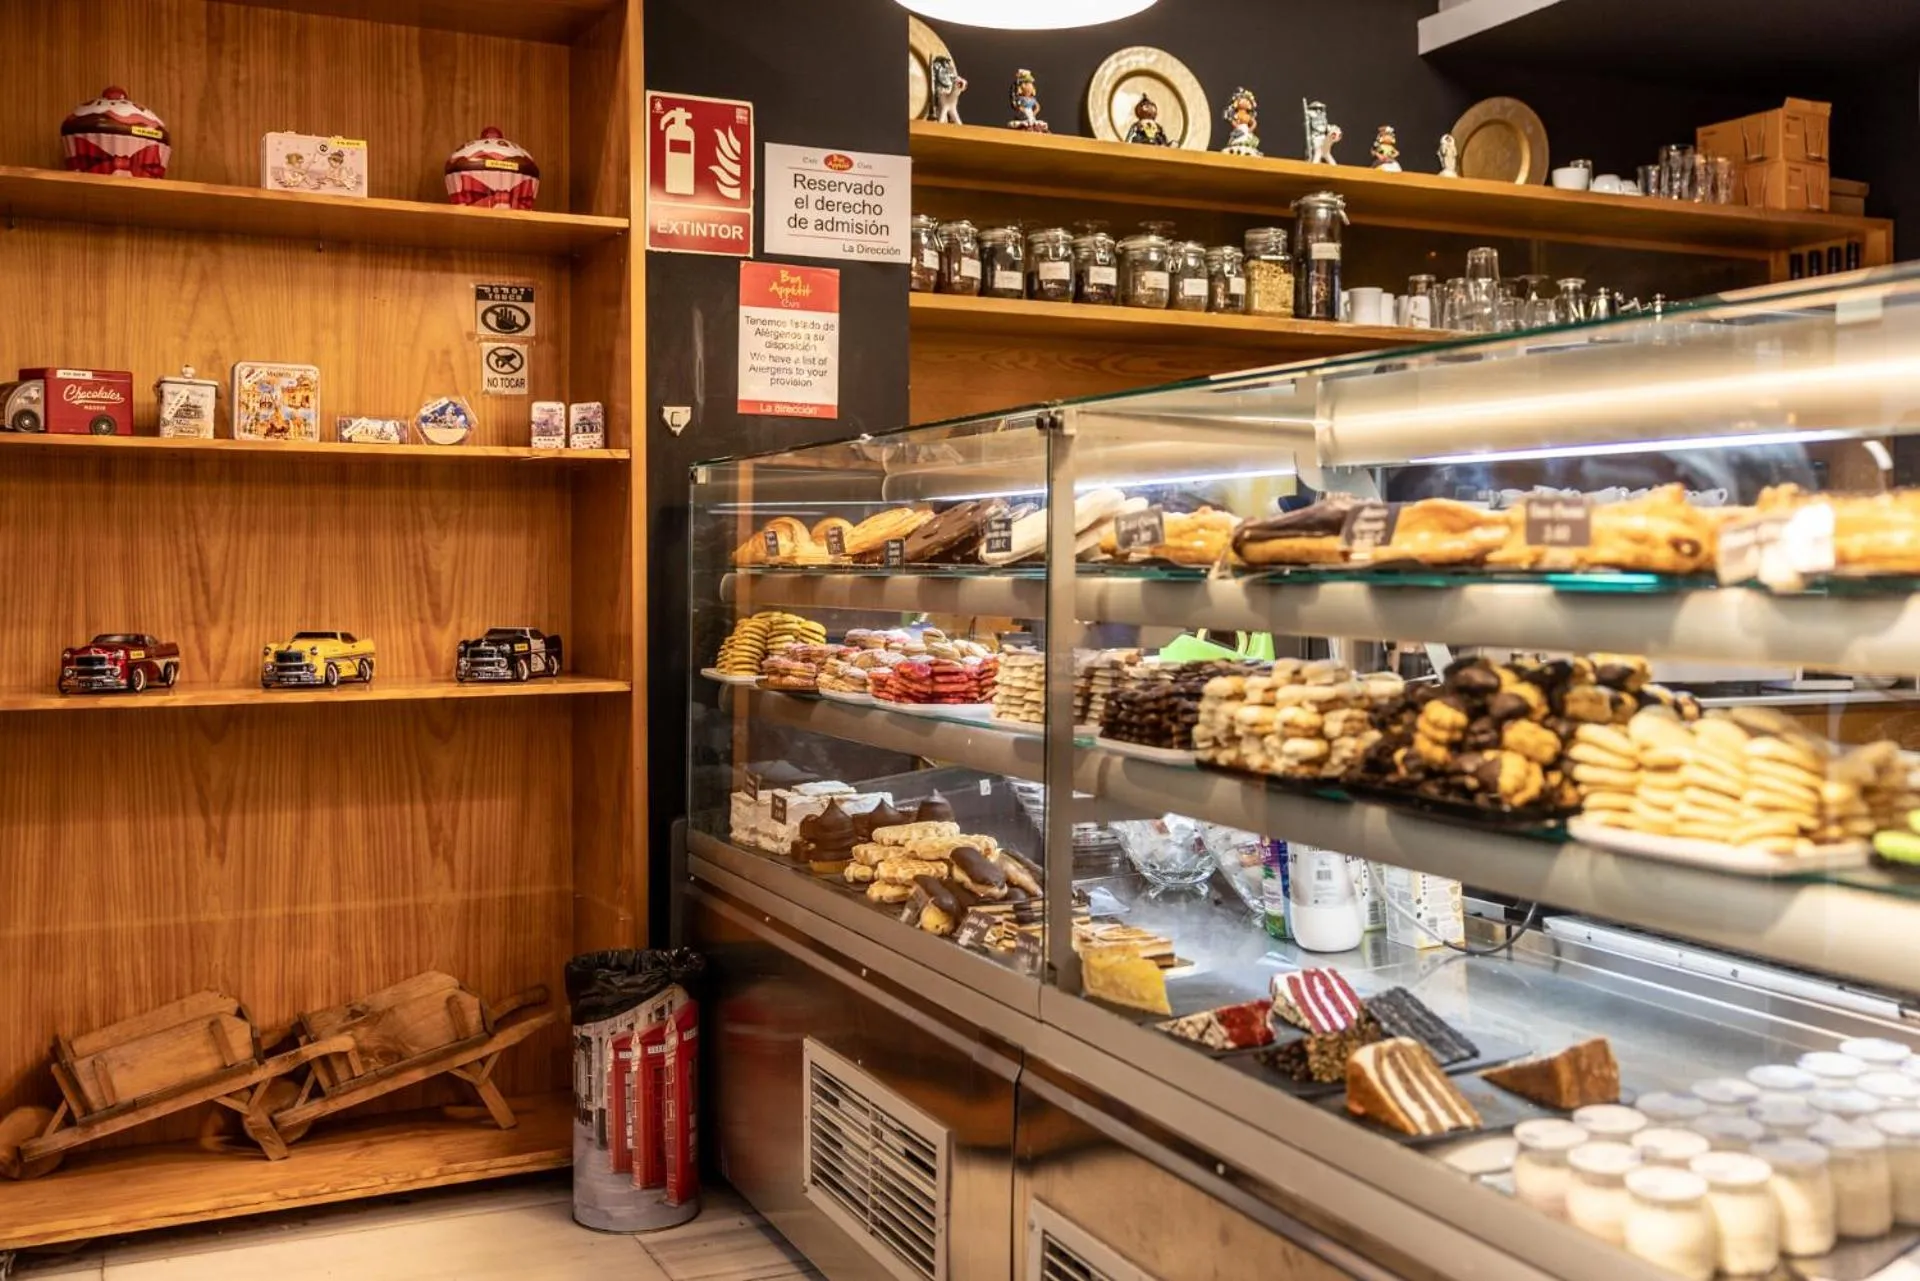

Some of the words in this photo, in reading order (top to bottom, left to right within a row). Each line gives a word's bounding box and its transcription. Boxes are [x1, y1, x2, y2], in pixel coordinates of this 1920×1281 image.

[793, 173, 885, 197] Reservado
[794, 195, 809, 210] el
[814, 196, 883, 216] derecho
[656, 219, 744, 241] EXTINTOR
[787, 213, 808, 230] de
[814, 217, 889, 237] admisión
[842, 243, 854, 253] La
[857, 243, 901, 256] Dirección
[823, 322, 835, 331] de
[814, 333, 825, 342] su
[769, 353, 792, 364] have
[802, 355, 816, 366] list
[818, 356, 828, 366] of
[796, 367, 805, 376] to
[807, 367, 828, 378] your
[487, 377, 499, 388] NO
[501, 378, 526, 389] TOCAR
[770, 377, 813, 387] provision
